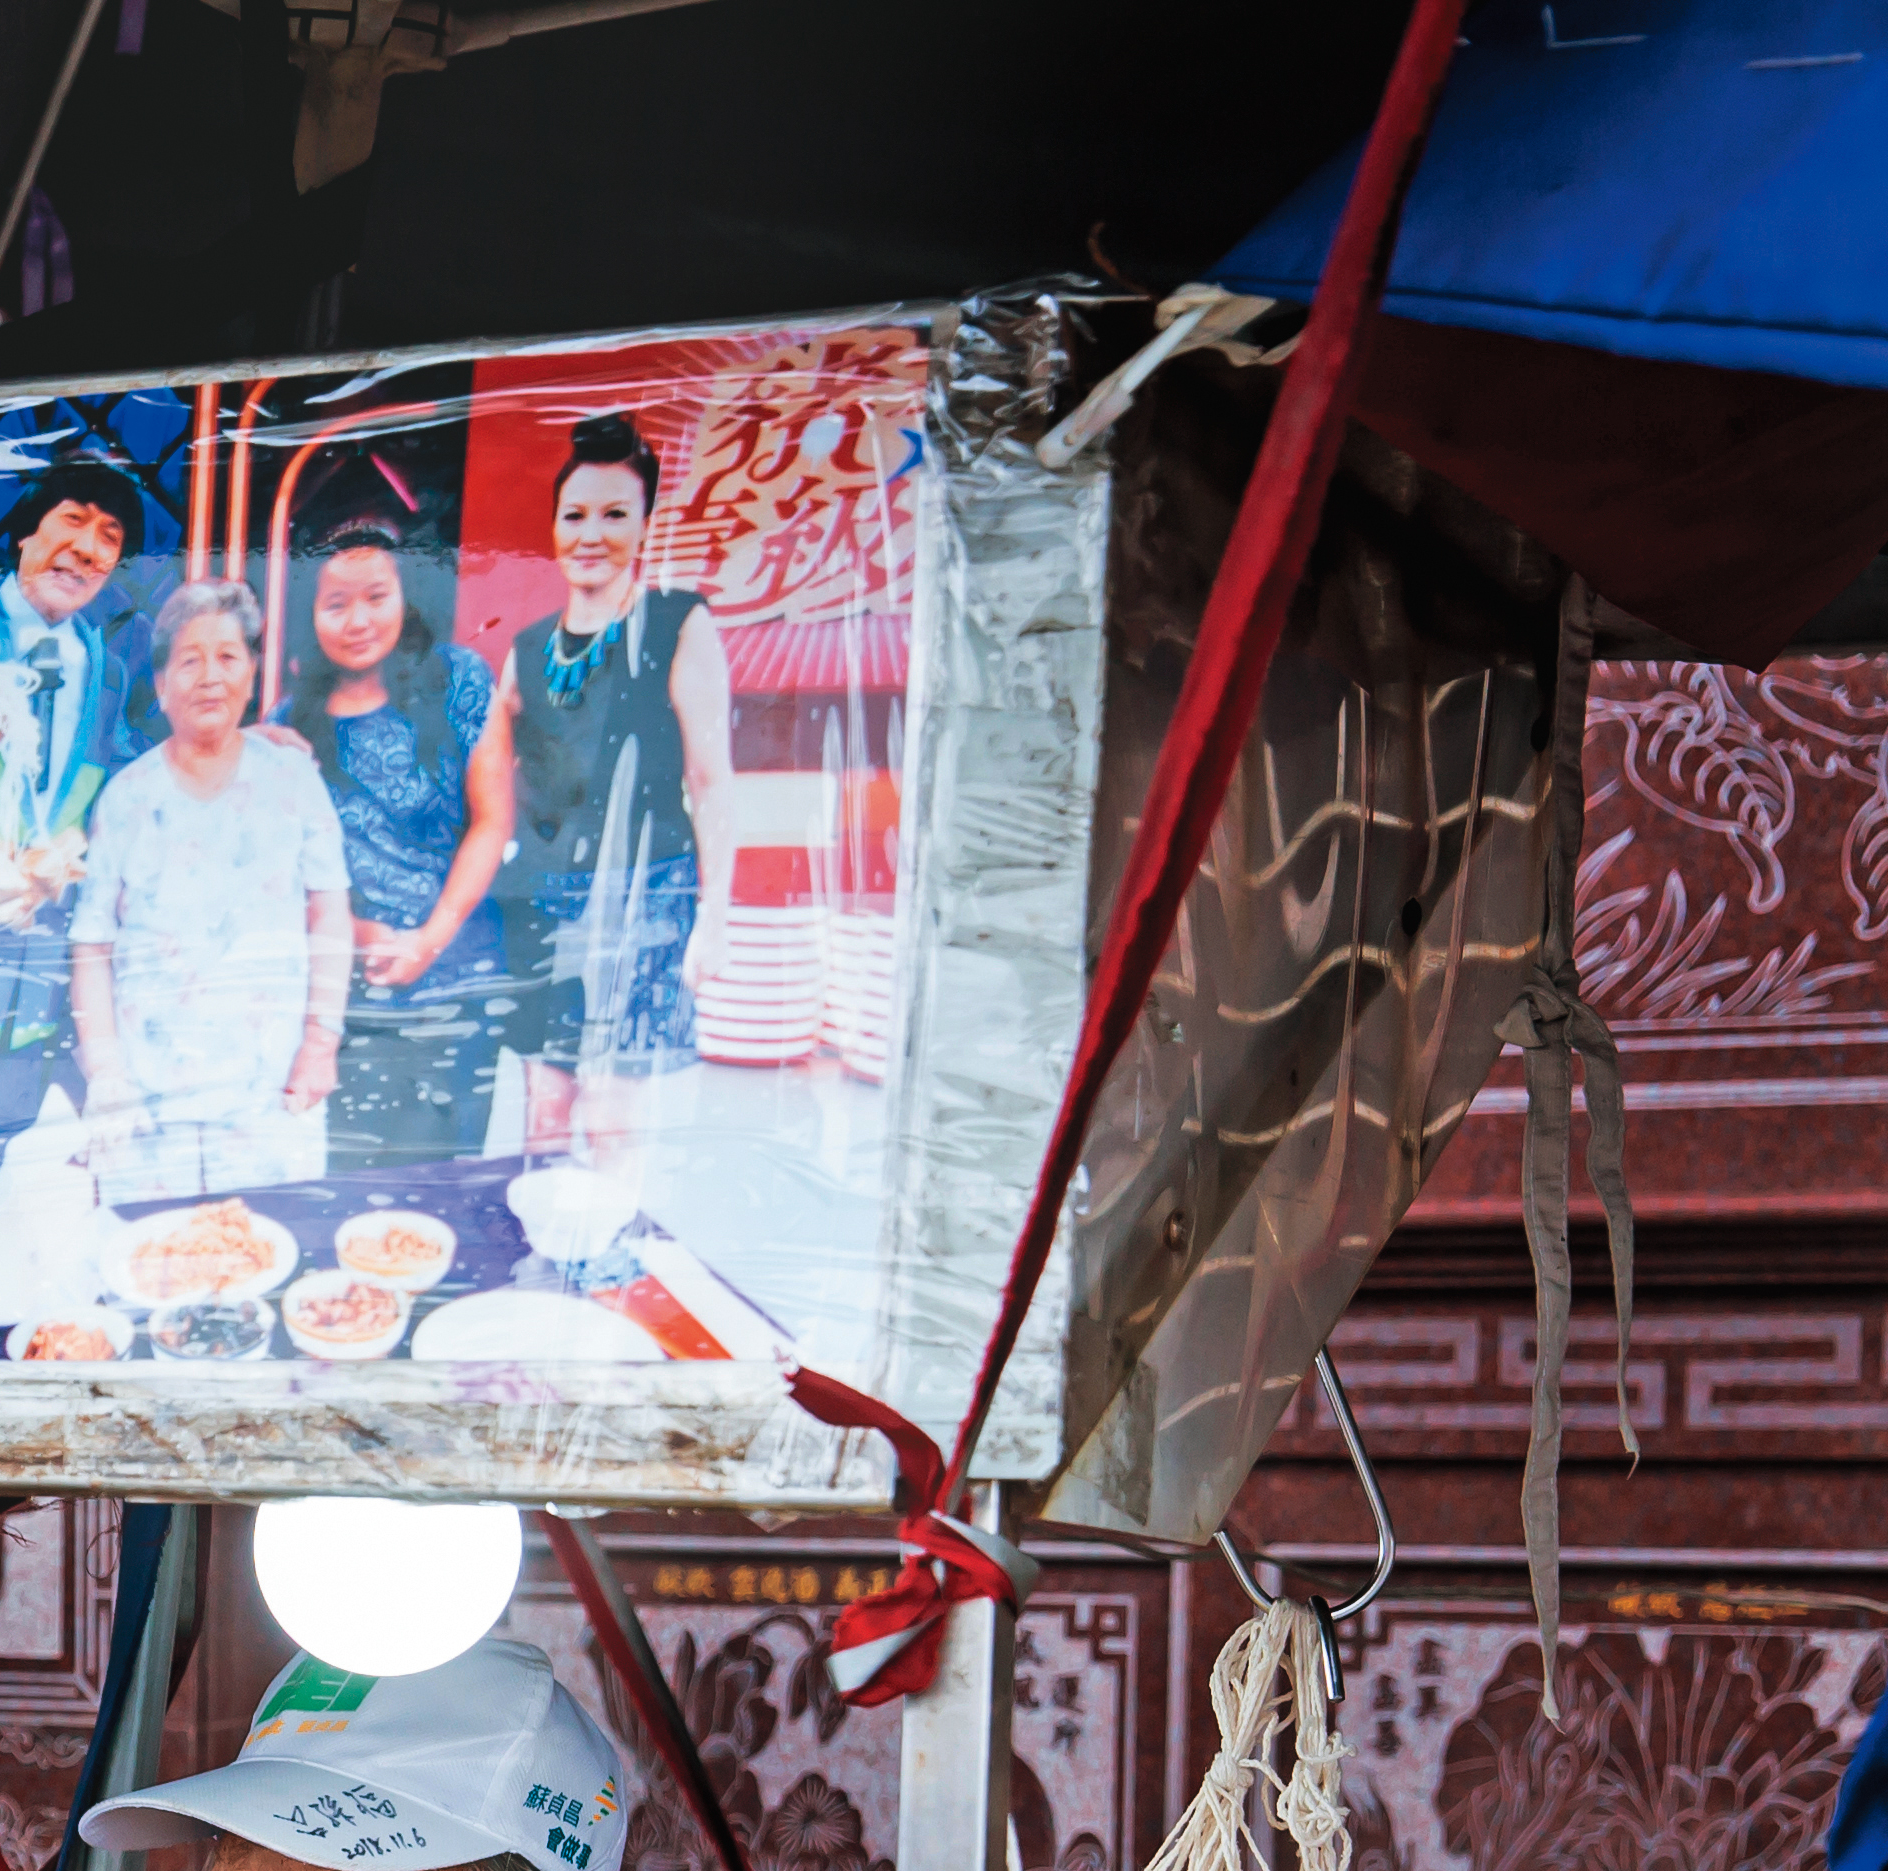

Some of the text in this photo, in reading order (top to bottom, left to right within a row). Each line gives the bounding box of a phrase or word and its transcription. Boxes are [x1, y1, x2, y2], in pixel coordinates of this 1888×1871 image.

[523, 1783, 584, 1828] 蘇貞昌
[546, 1826, 593, 1870] 會做事
